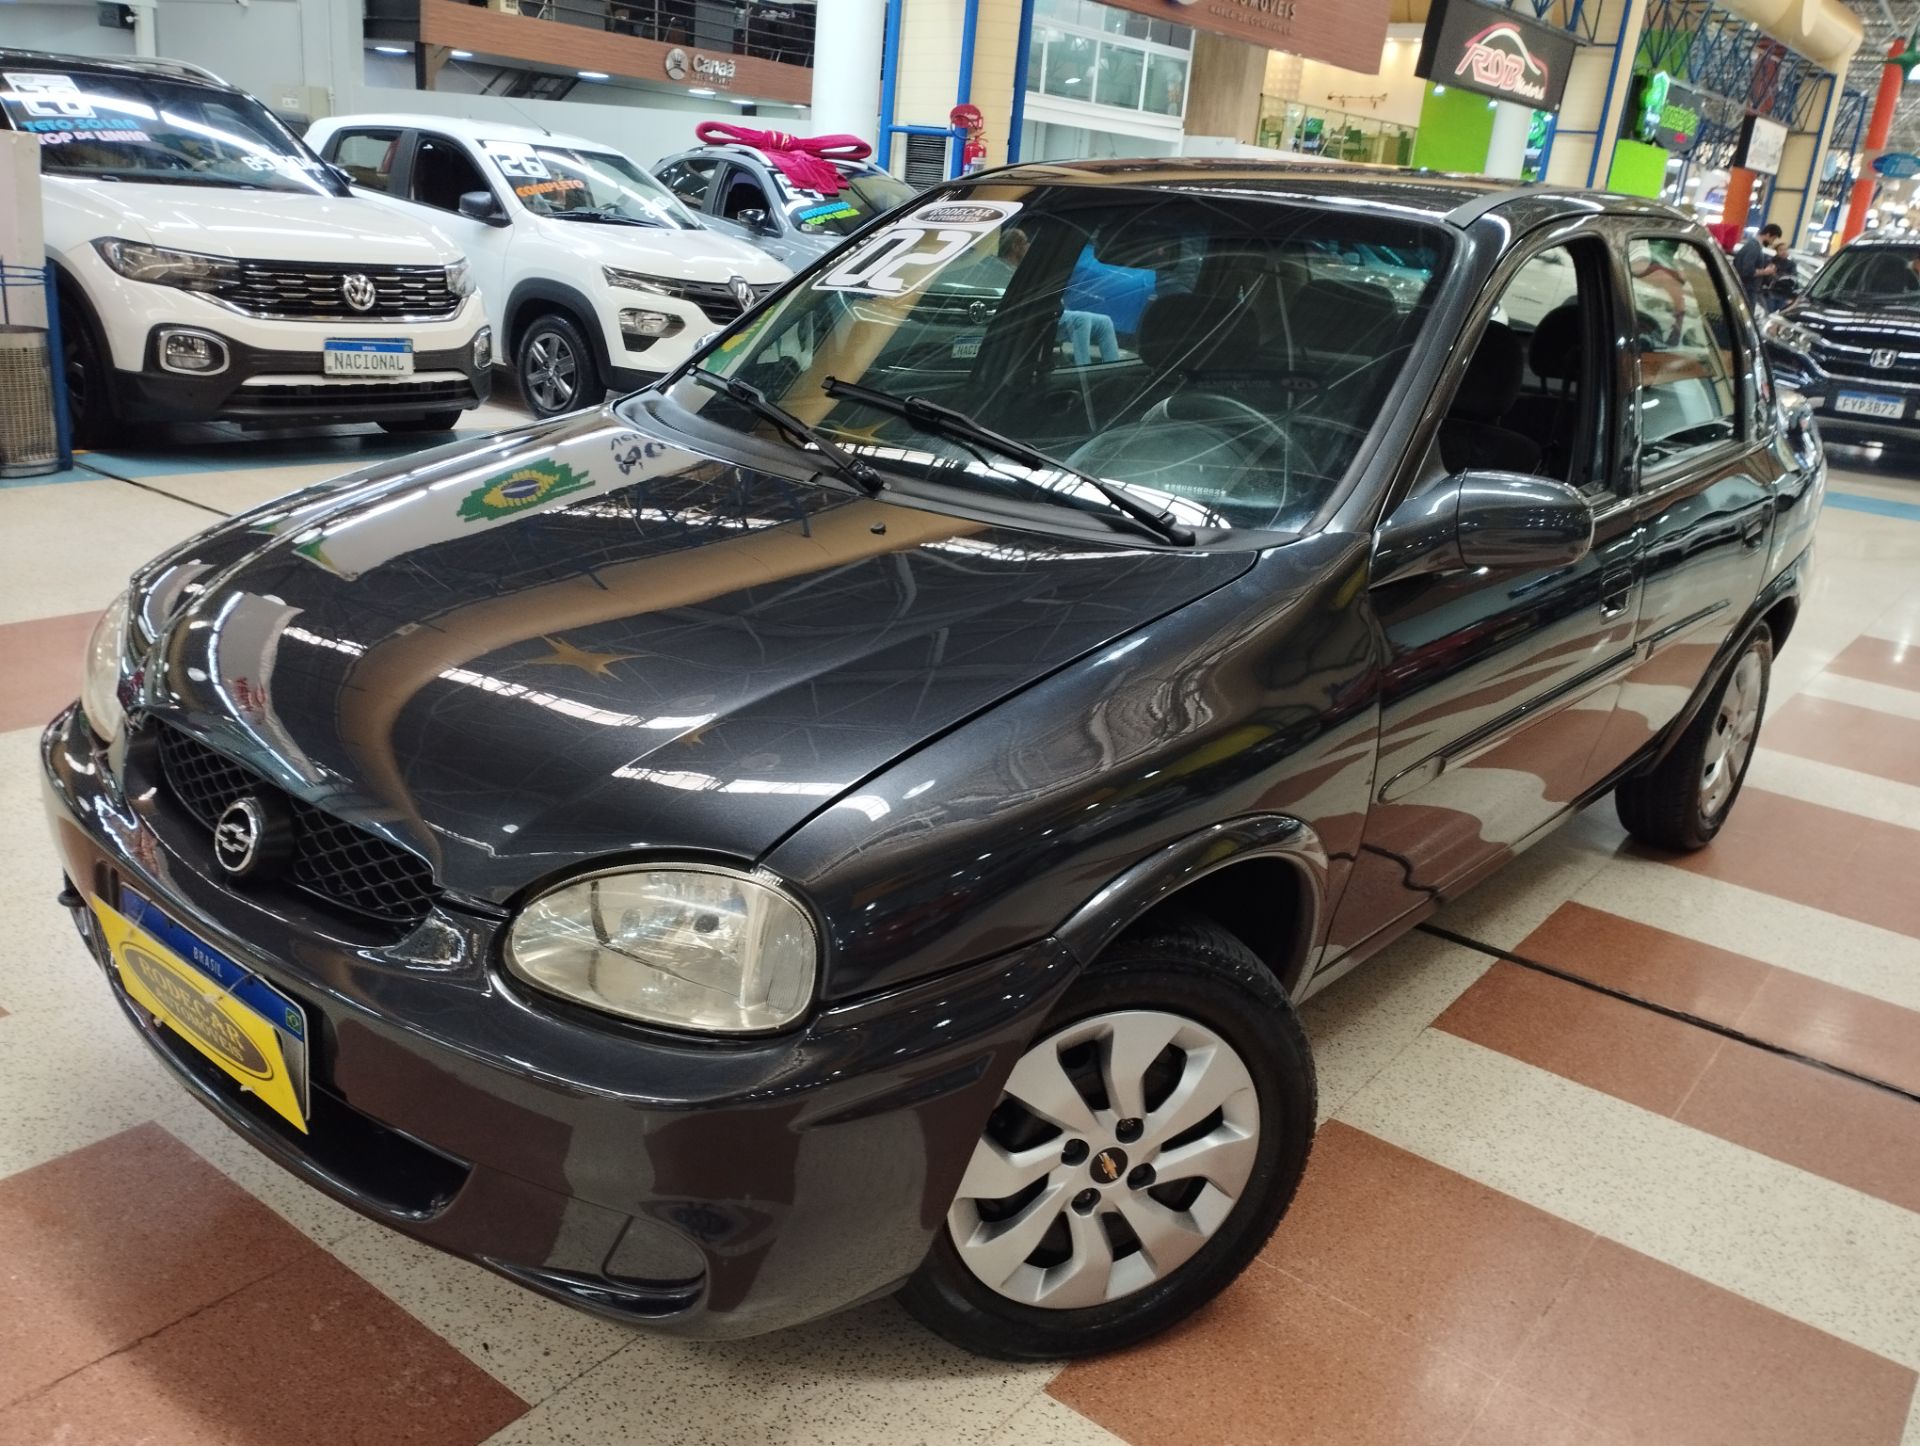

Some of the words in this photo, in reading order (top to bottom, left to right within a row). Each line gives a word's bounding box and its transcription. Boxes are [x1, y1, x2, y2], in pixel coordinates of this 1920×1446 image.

[693, 54, 736, 77] Canaã
[22, 119, 74, 132] TETO
[75, 118, 139, 130] SOLAR
[496, 152, 549, 176] 26
[515, 179, 585, 197] COMPLETO
[825, 229, 974, 291] 02
[334, 352, 405, 370] NACIONAL
[193, 946, 223, 978] BRASIL
[137, 957, 246, 1050] RODECAR
